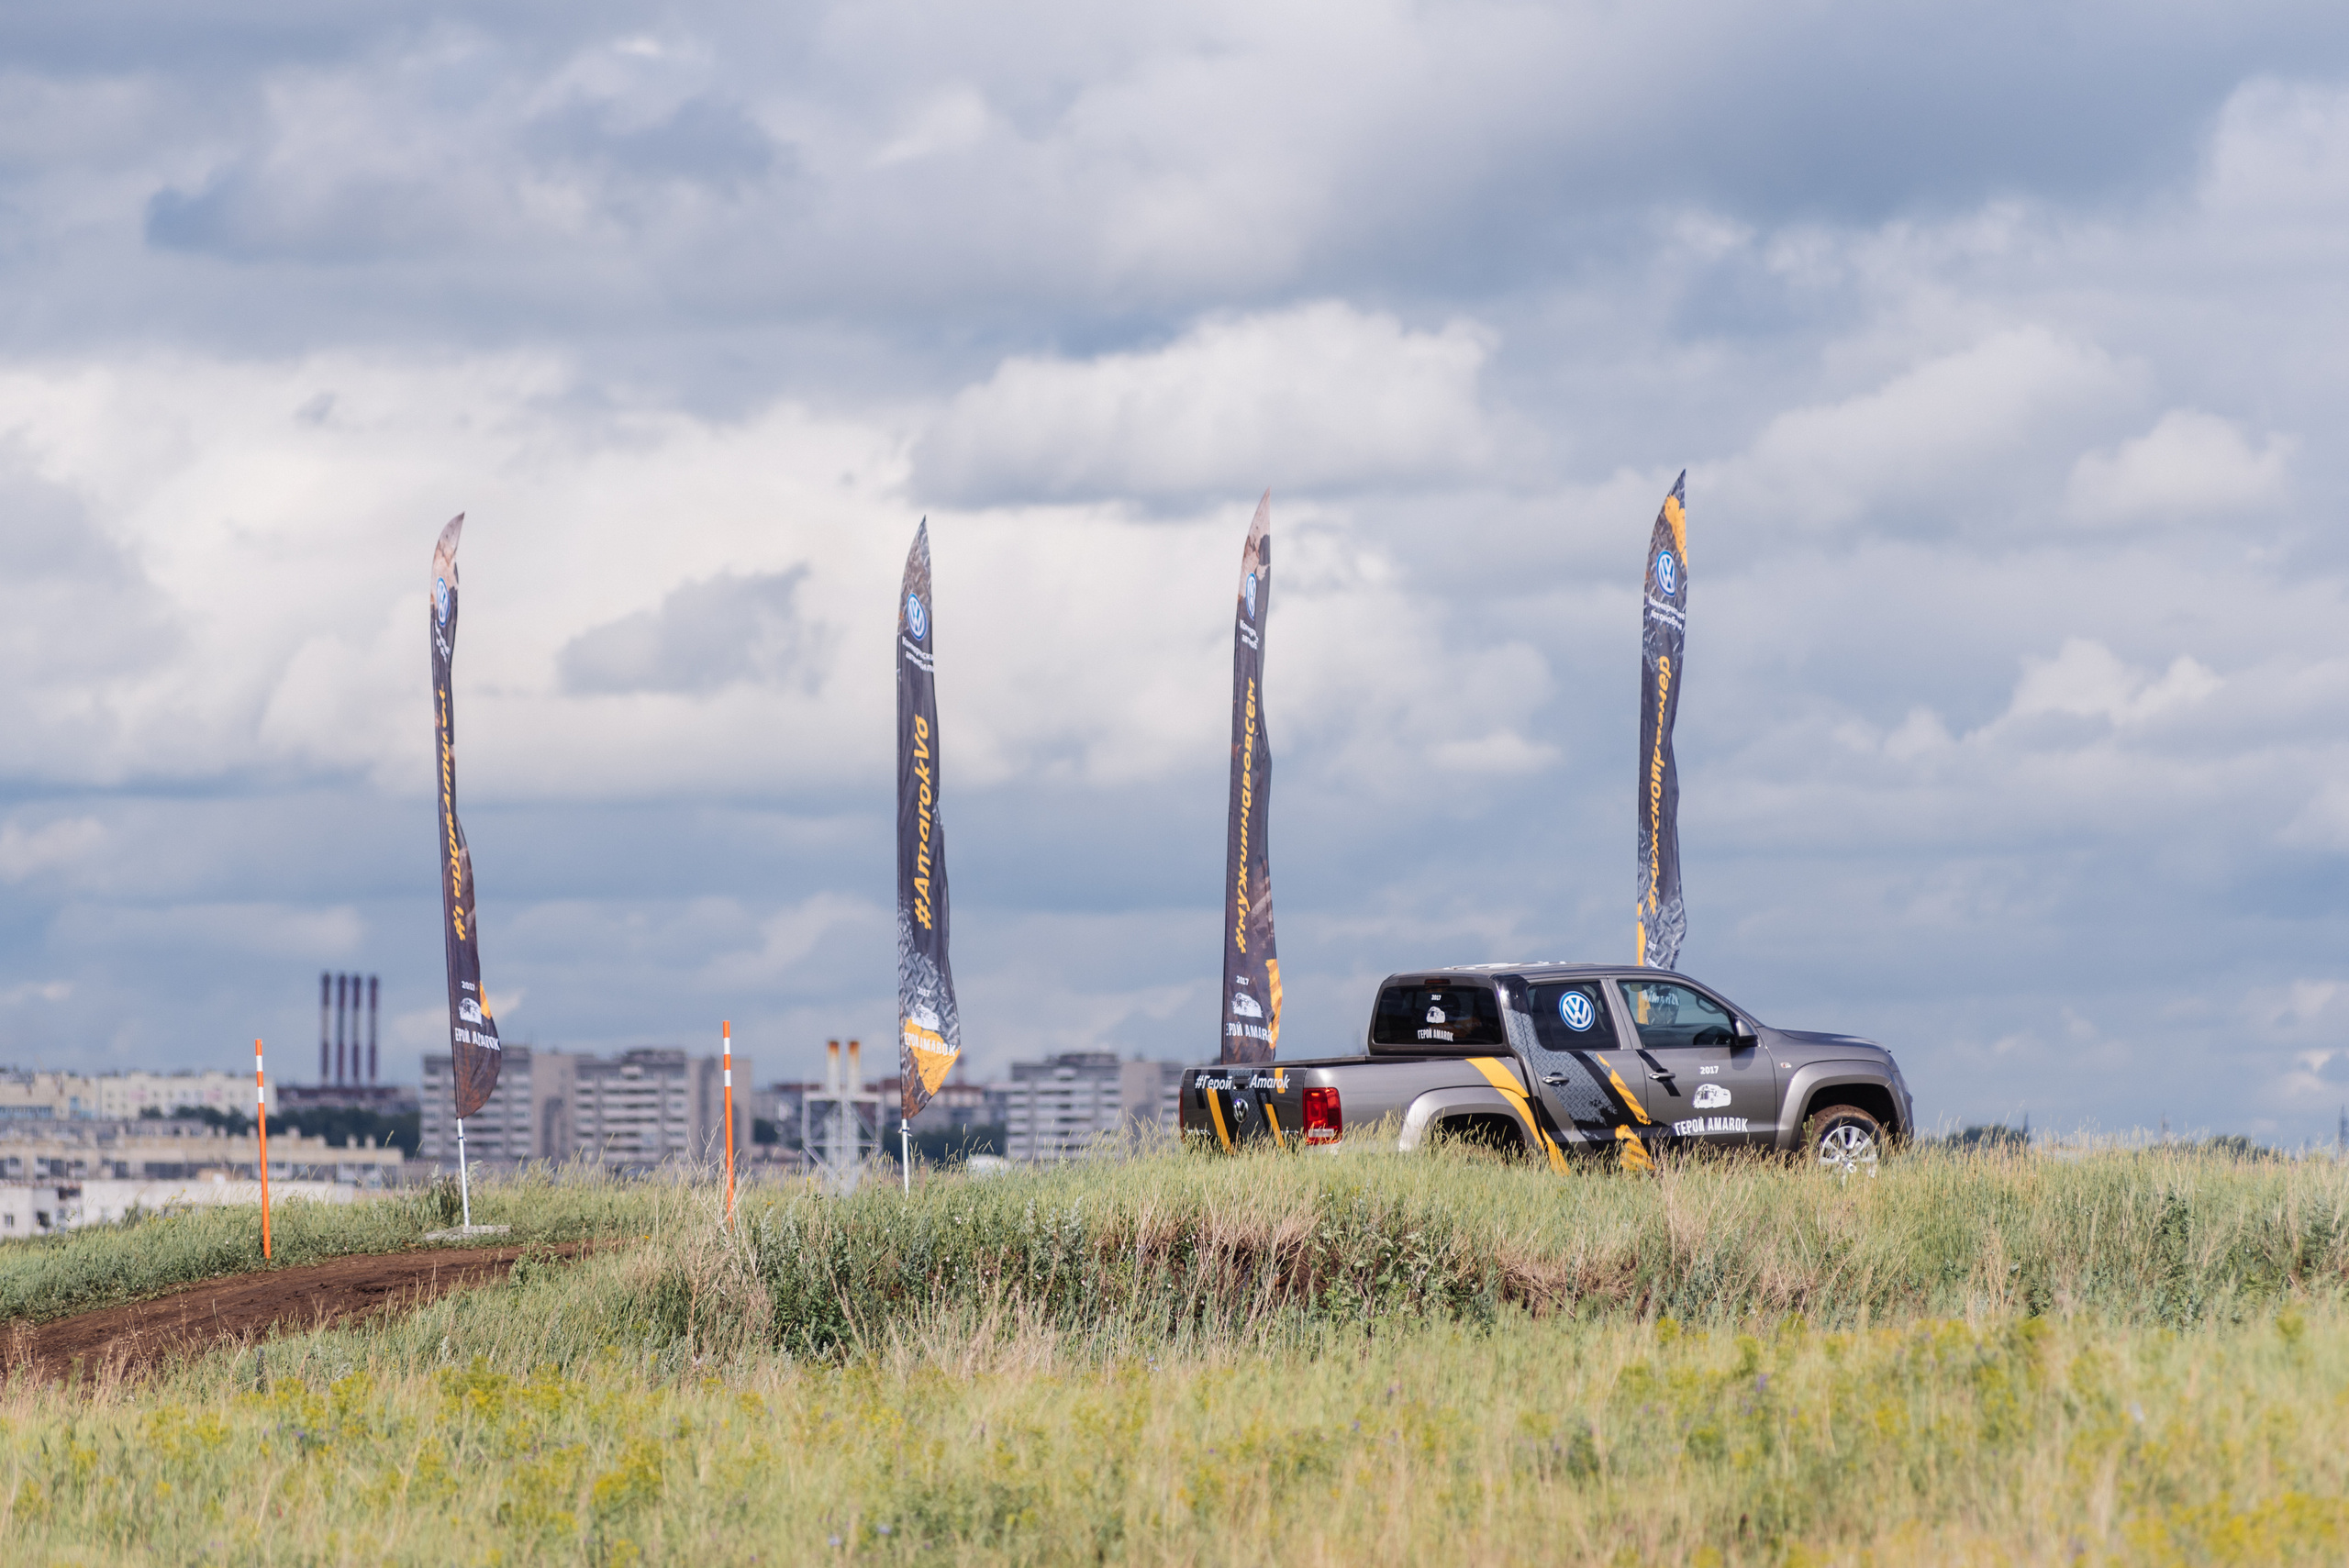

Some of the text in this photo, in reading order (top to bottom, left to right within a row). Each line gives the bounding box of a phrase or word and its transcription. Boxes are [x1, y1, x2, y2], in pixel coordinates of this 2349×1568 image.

[914, 714, 932, 930] #AmarokV6
[1235, 677, 1256, 953] #мужчинавовсем
[462, 981, 475, 991] 2017
[1236, 975, 1249, 985] 2017
[1700, 1066, 1719, 1075] 2017
[1195, 1074, 1290, 1093] #Герой Amarok
[1675, 1117, 1748, 1136] ГЕРОЙ AMAROK
